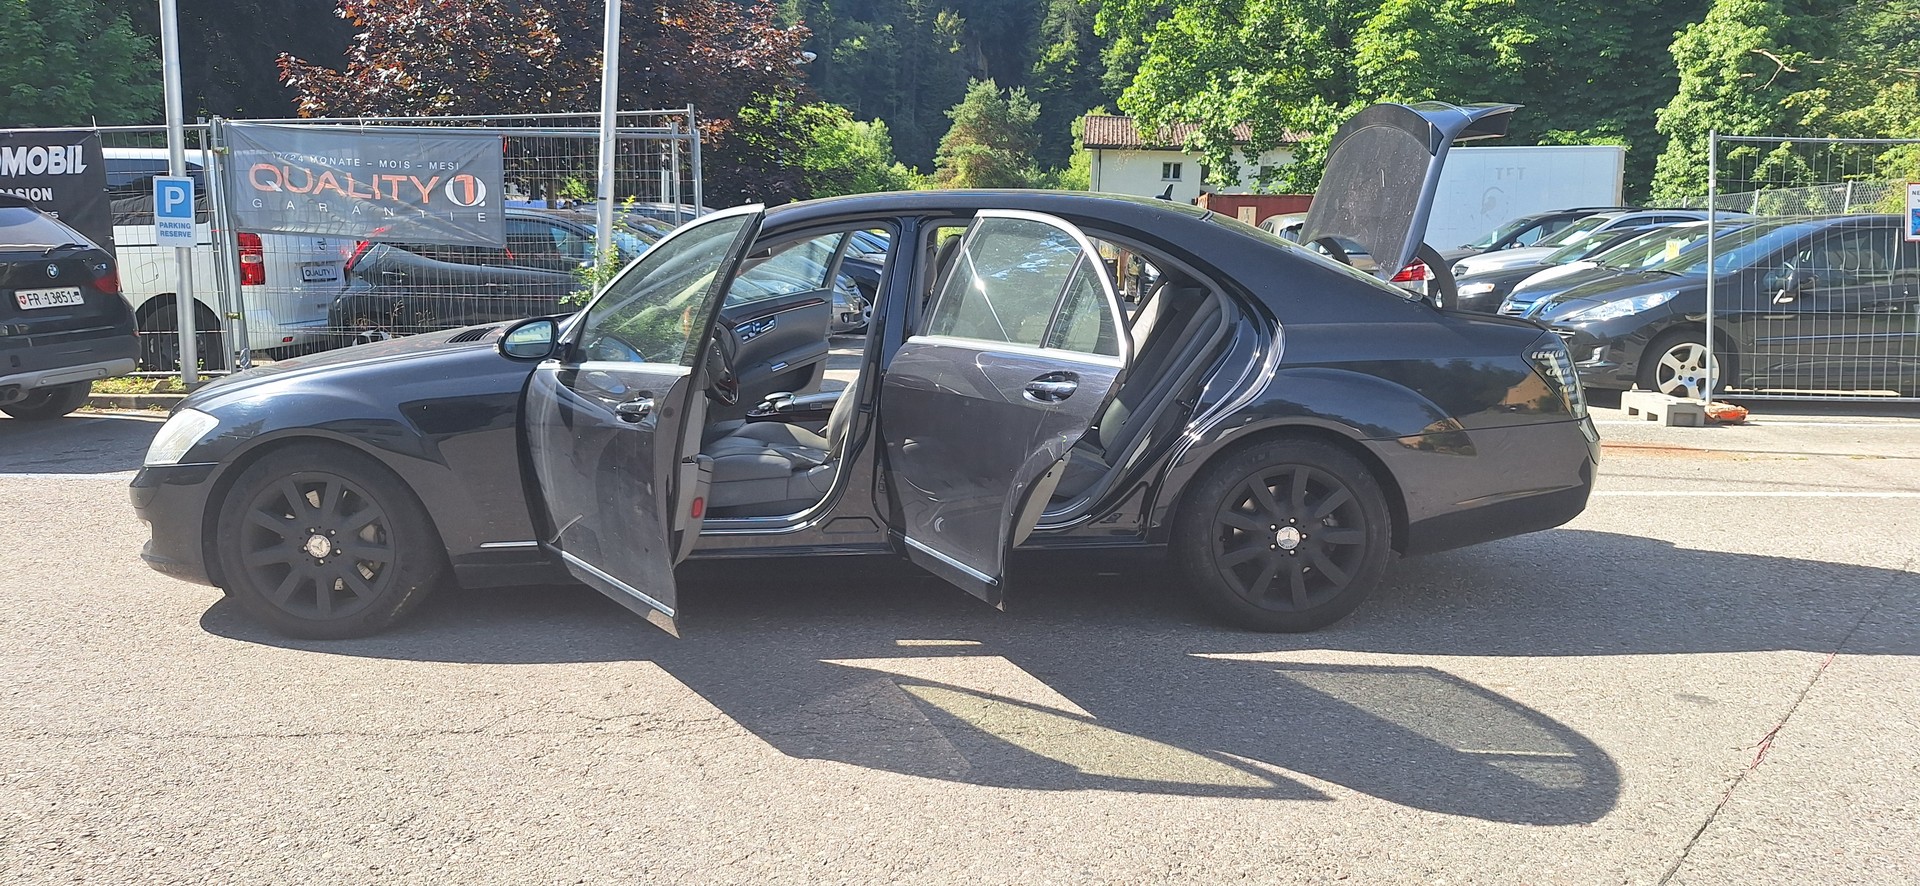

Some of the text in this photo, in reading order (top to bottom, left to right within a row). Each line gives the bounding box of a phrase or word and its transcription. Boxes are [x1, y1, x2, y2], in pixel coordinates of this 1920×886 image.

[0, 145, 88, 179] MOBIL
[309, 155, 361, 167] MONATE
[379, 159, 411, 169] MOIS
[429, 161, 459, 170] MESI
[248, 163, 440, 204] QUALITY
[165, 186, 185, 213] P
[252, 198, 486, 223] GARANTIE
[159, 221, 192, 230] PARKING
[159, 230, 192, 238] RESERVE
